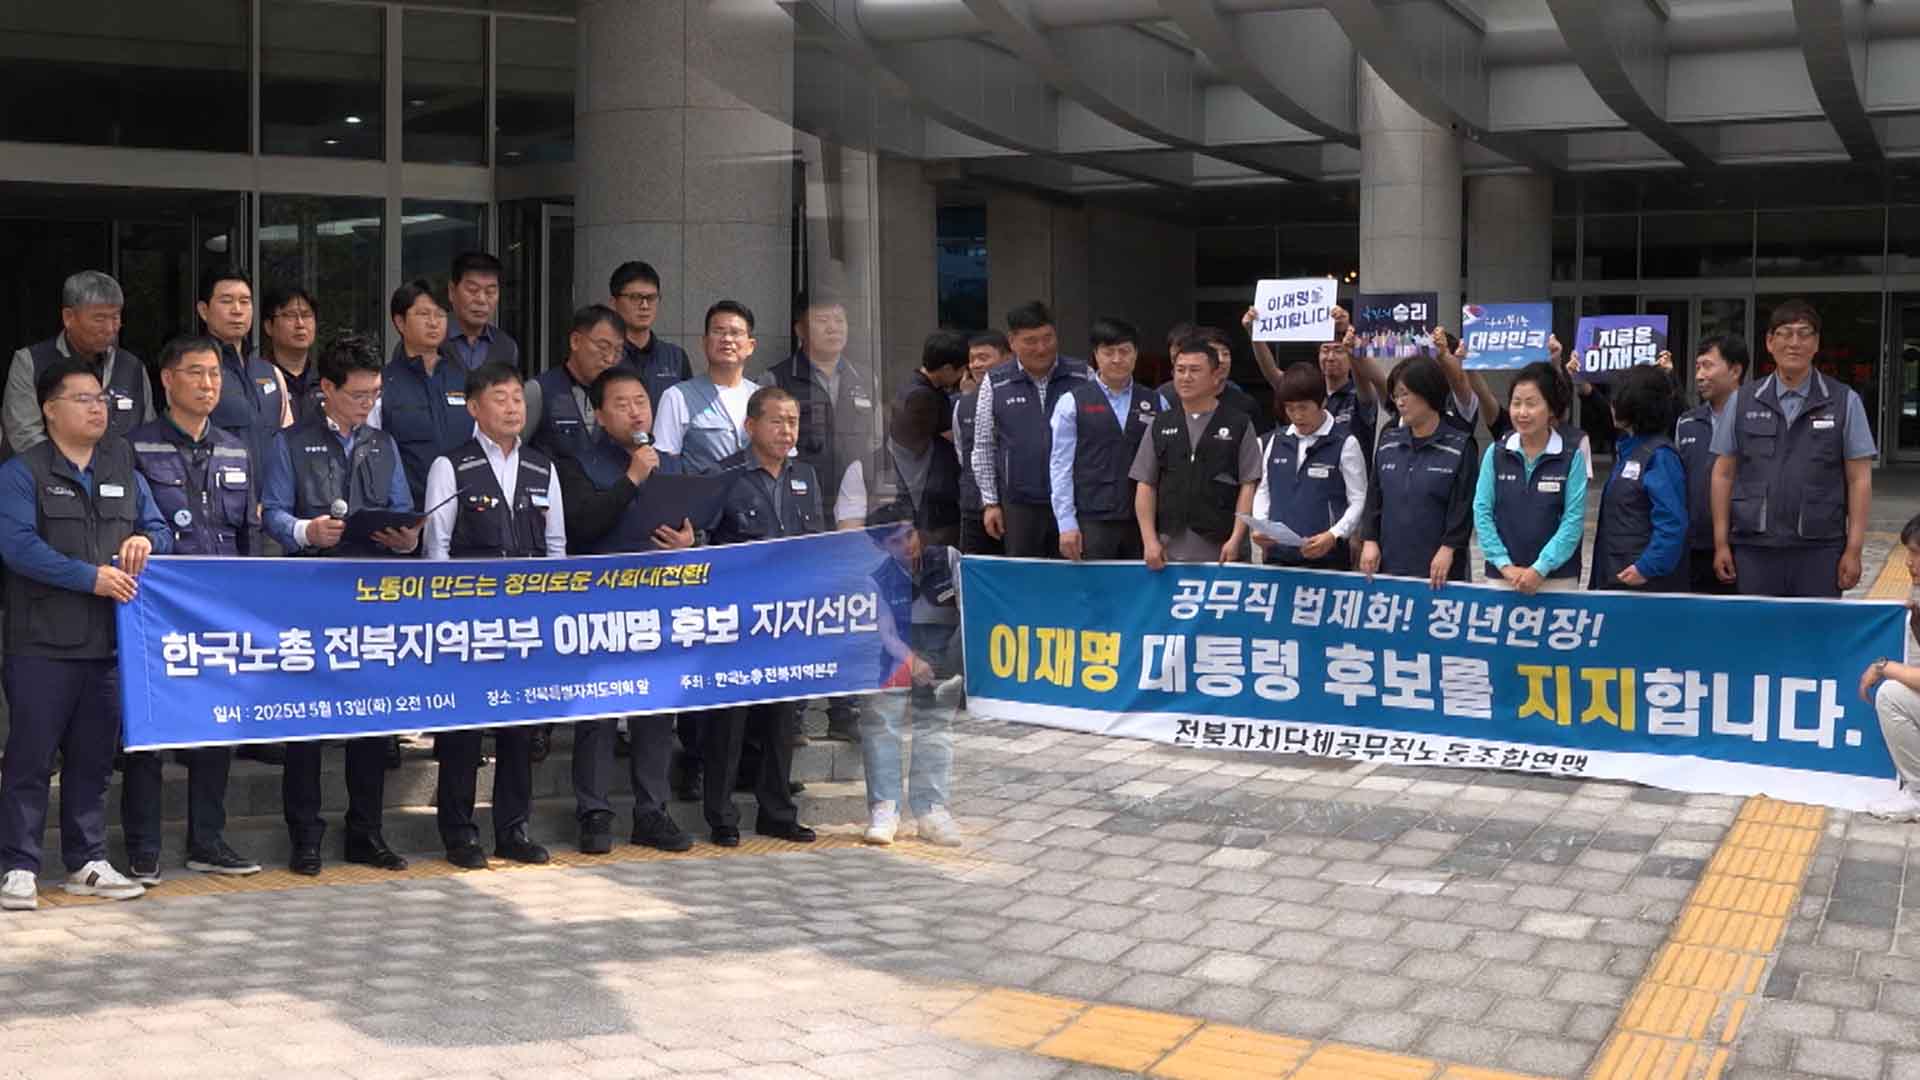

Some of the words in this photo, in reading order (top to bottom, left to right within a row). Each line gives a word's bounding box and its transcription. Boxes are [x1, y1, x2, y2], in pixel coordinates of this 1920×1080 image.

[1259, 305, 1330, 333] 지지합니다
[1392, 303, 1427, 322] 승리
[1467, 329, 1546, 352] 대한민국
[1598, 326, 1653, 348] 지금은
[1584, 343, 1658, 373] 이재명
[356, 575, 424, 602] 노동이
[430, 573, 498, 599] 만드는
[504, 570, 593, 596] 정의로운
[596, 562, 712, 590] 사회대전환!
[1170, 578, 1279, 623] 공무직
[1291, 584, 1415, 634] 법제화!
[1428, 598, 1605, 651] 정년연장!
[160, 627, 316, 677] 한국노총
[323, 615, 543, 672] 전북지역본부
[553, 609, 662, 656] 이재명
[670, 604, 740, 648] 후보
[750, 591, 880, 639] 지지선언
[486, 688, 512, 706] 장소
[989, 623, 1122, 693] 이재명
[1138, 633, 1301, 702] 대통령
[1323, 642, 1494, 720] 후보를
[1516, 664, 1863, 749] 지지합니다.
[213, 705, 241, 724] 일시
[254, 701, 306, 722] 2025년
[309, 701, 332, 720] 5월
[335, 697, 392, 717] 13일(화)
[395, 694, 421, 713] 오전
[425, 692, 456, 710] 10시
